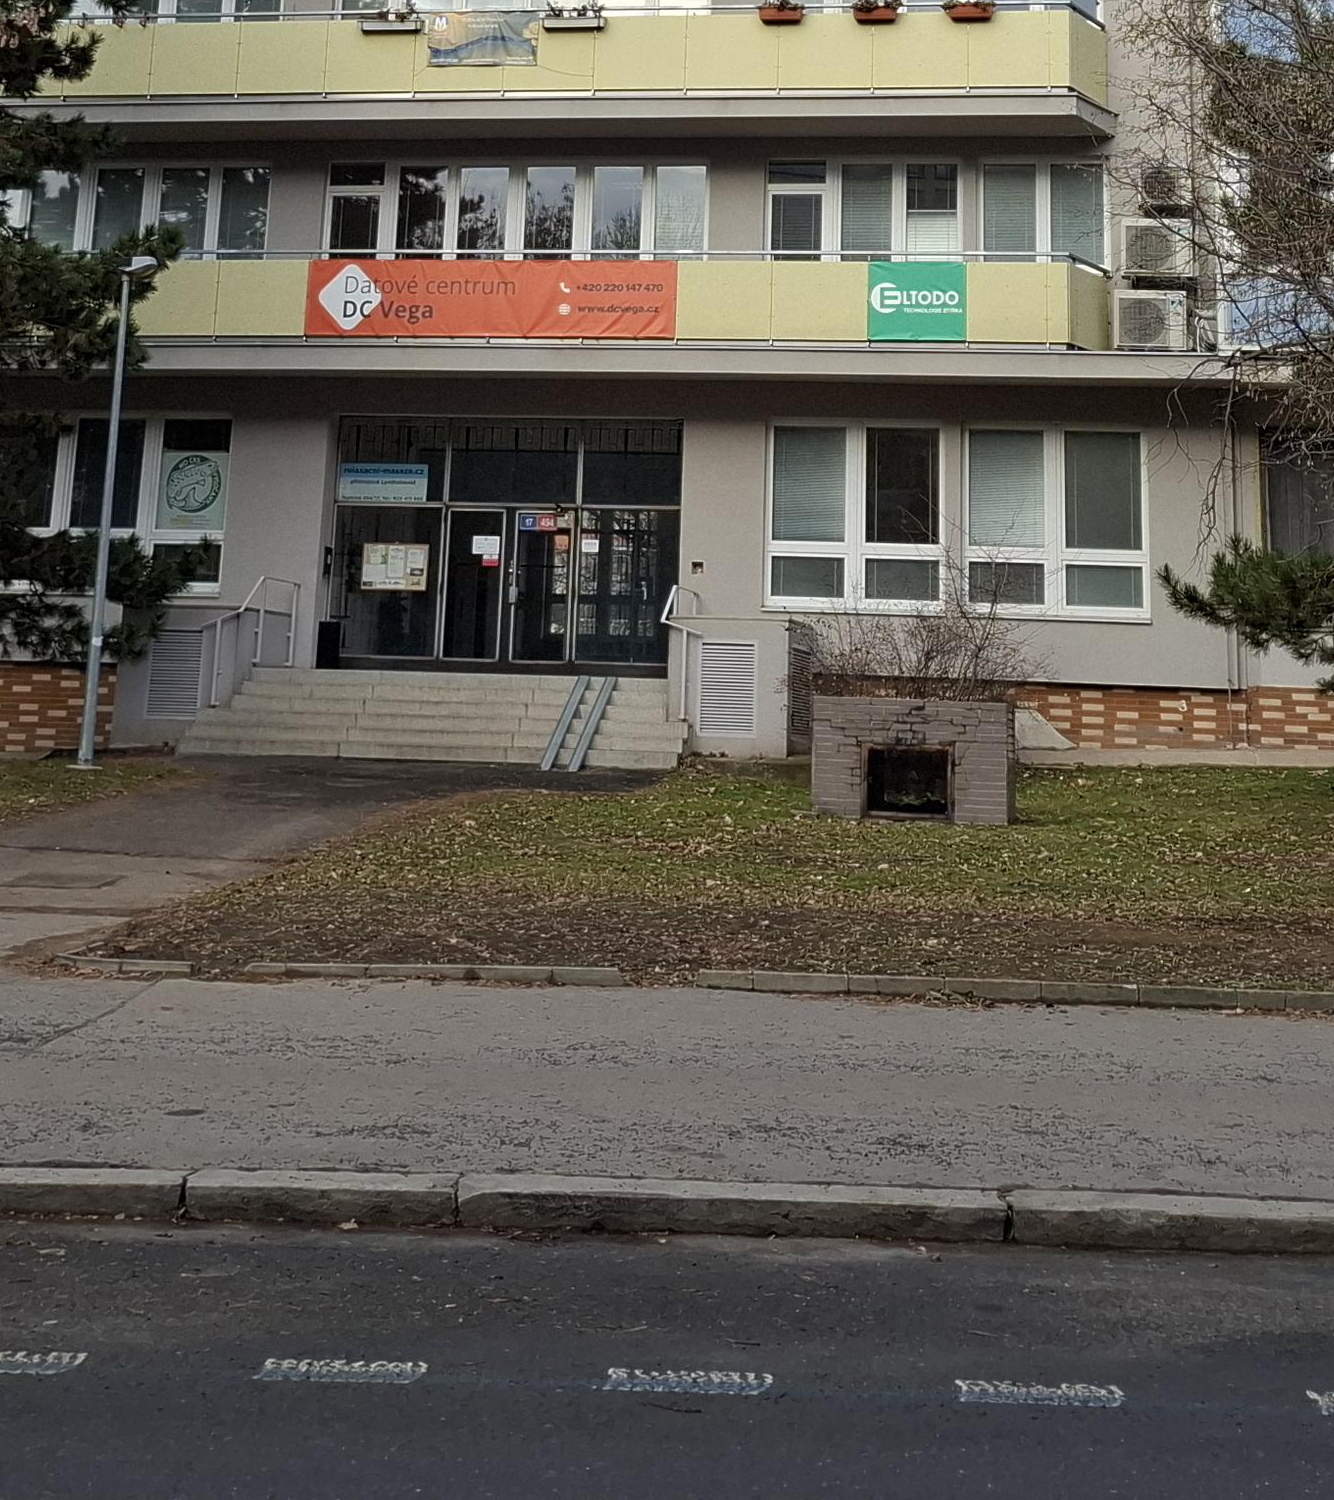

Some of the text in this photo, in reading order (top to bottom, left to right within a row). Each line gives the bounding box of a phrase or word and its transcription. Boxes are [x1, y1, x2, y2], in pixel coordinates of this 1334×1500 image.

[344, 275, 516, 295] Datové centrum
[576, 283, 664, 292] +420 220 147 470
[870, 282, 959, 314] ELTODO
[342, 301, 434, 324] DC Vega
[577, 304, 660, 314] www.dcvega.cz
[525, 518, 534, 527] 17
